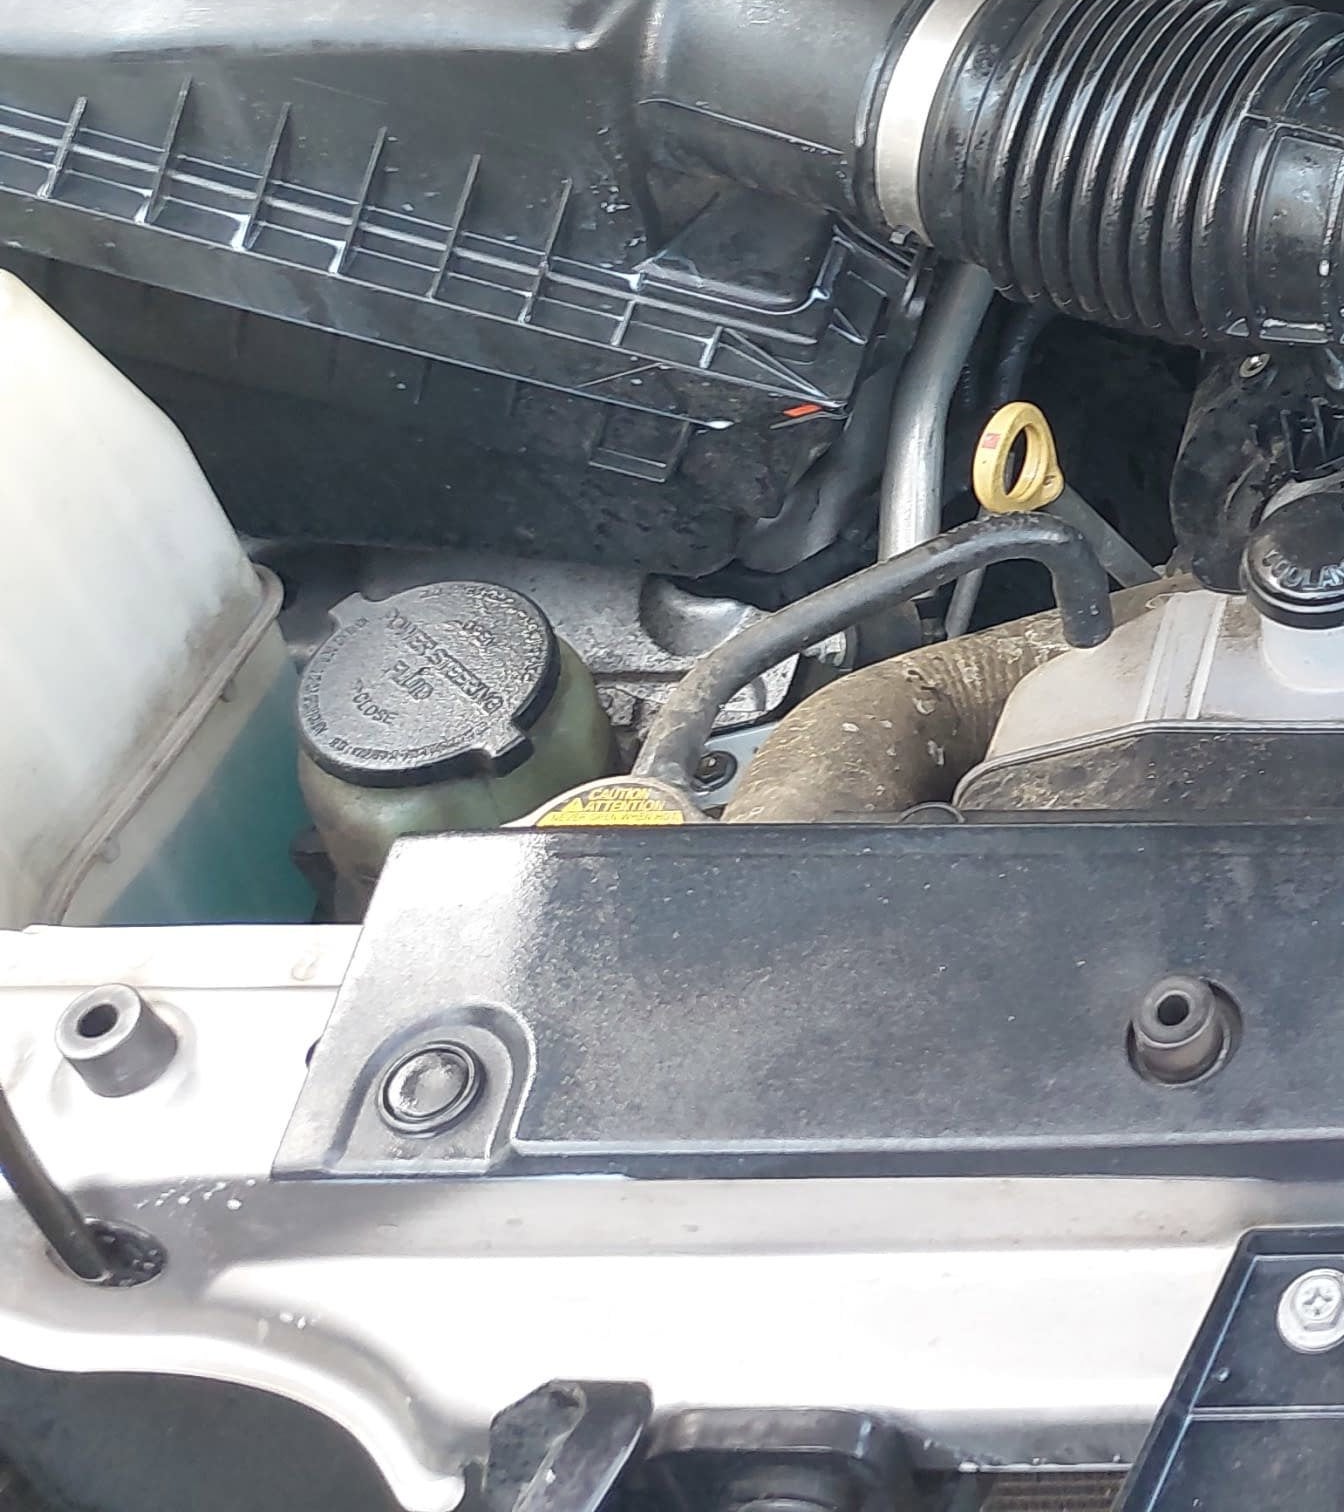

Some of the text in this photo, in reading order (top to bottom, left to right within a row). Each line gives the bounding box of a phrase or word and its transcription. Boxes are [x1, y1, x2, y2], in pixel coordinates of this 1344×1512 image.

[351, 691, 400, 725] CLOSE
[588, 788, 650, 800] CAUTION
[583, 799, 665, 811] ATTENTION
